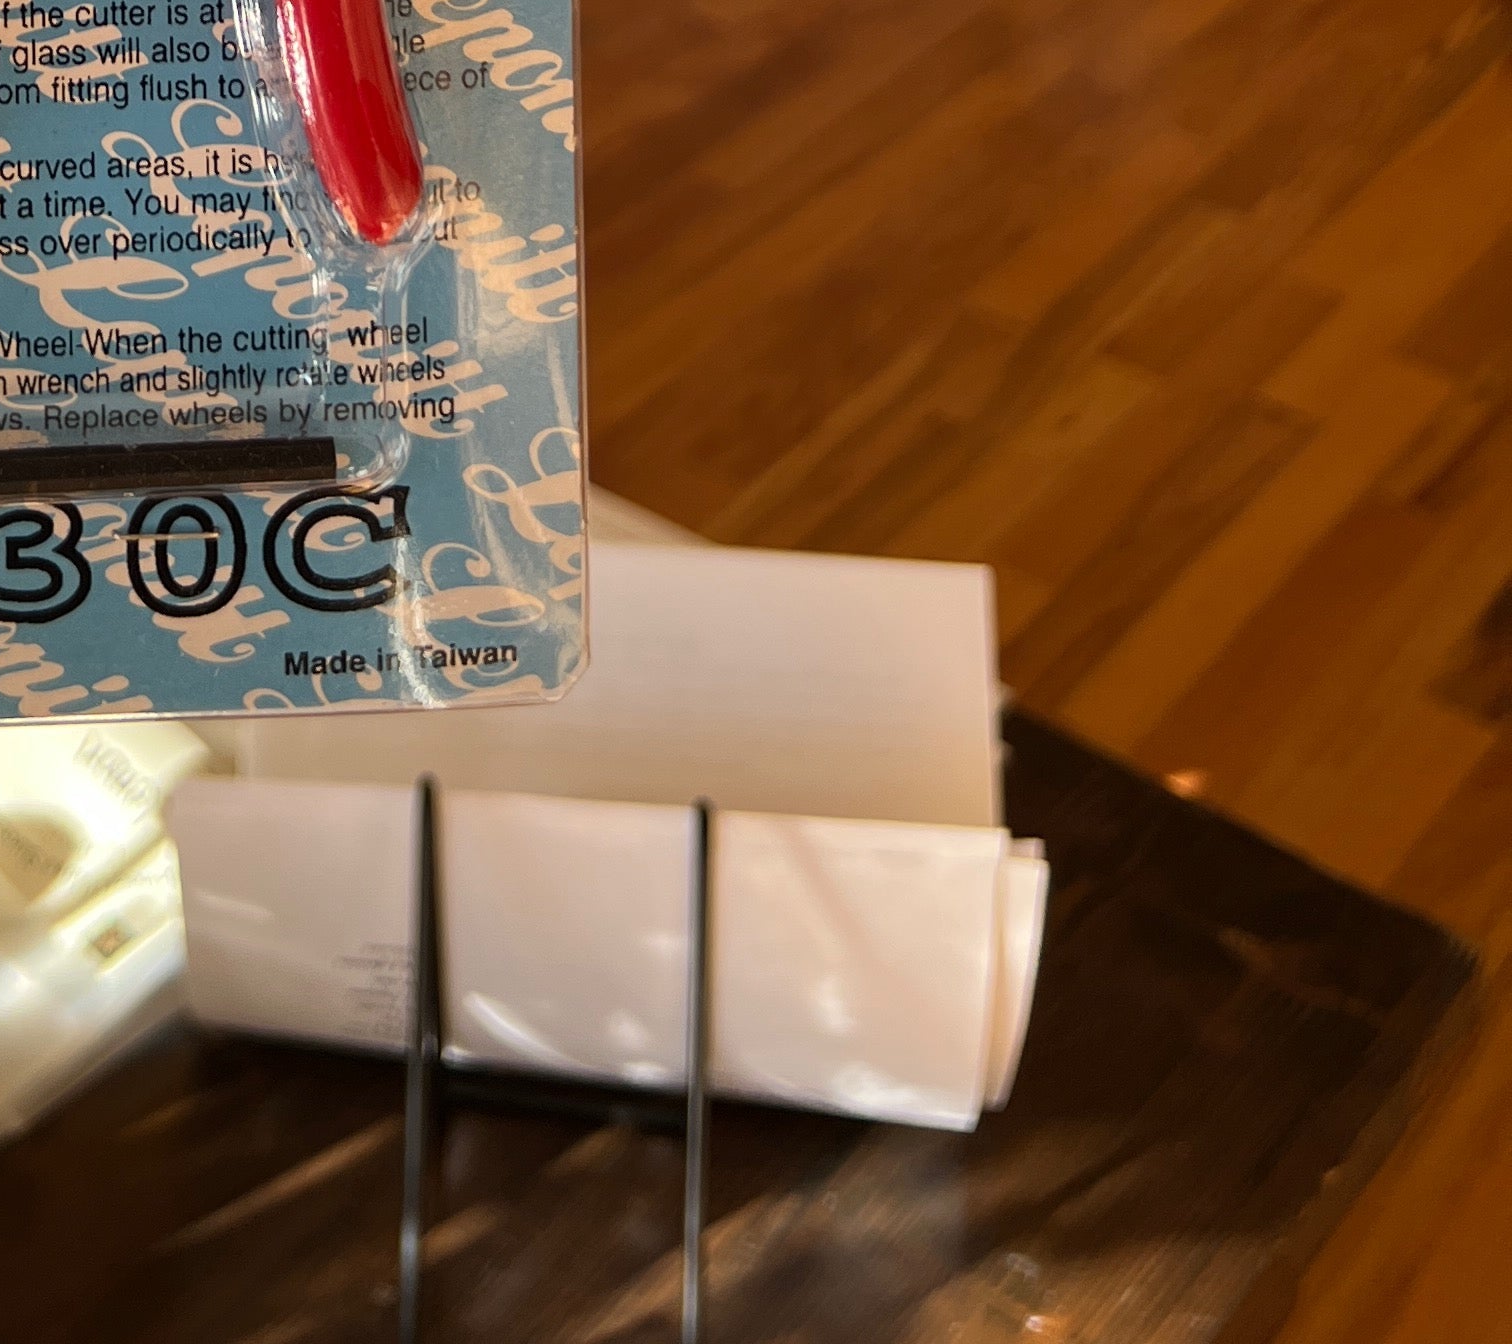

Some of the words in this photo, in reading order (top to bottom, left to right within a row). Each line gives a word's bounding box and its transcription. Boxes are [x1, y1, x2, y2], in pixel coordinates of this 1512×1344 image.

[20, 1, 64, 28] the
[74, 0, 156, 27] cutter
[199, 0, 225, 25] at
[12, 43, 88, 73] glass
[97, 38, 141, 65] will
[151, 36, 211, 64] also
[51, 76, 129, 109] fitting
[140, 74, 209, 103] flush
[217, 75, 246, 100] to
[461, 62, 489, 91] of
[106, 151, 194, 180] areas,
[204, 149, 220, 175] it
[230, 147, 253, 173] is
[16, 198, 34, 220] a
[43, 190, 114, 218] time.
[123, 186, 180, 216] You
[191, 189, 252, 222] may
[455, 178, 482, 203] to
[39, 230, 101, 255] over
[112, 223, 276, 260] periodically
[286, 226, 312, 249] to
[178, 325, 223, 354] the
[232, 322, 329, 355] cutting
[346, 316, 429, 349] wheel
[16, 365, 110, 396] wrench
[120, 363, 169, 392] and
[176, 360, 267, 397] slightly
[357, 354, 446, 383] wheels
[44, 404, 159, 439] Replace
[168, 400, 268, 428] wheels
[279, 399, 312, 430] by
[322, 392, 457, 425] removing
[283, 645, 366, 676] Made
[375, 643, 397, 672] in
[414, 638, 519, 672] Taiwan
